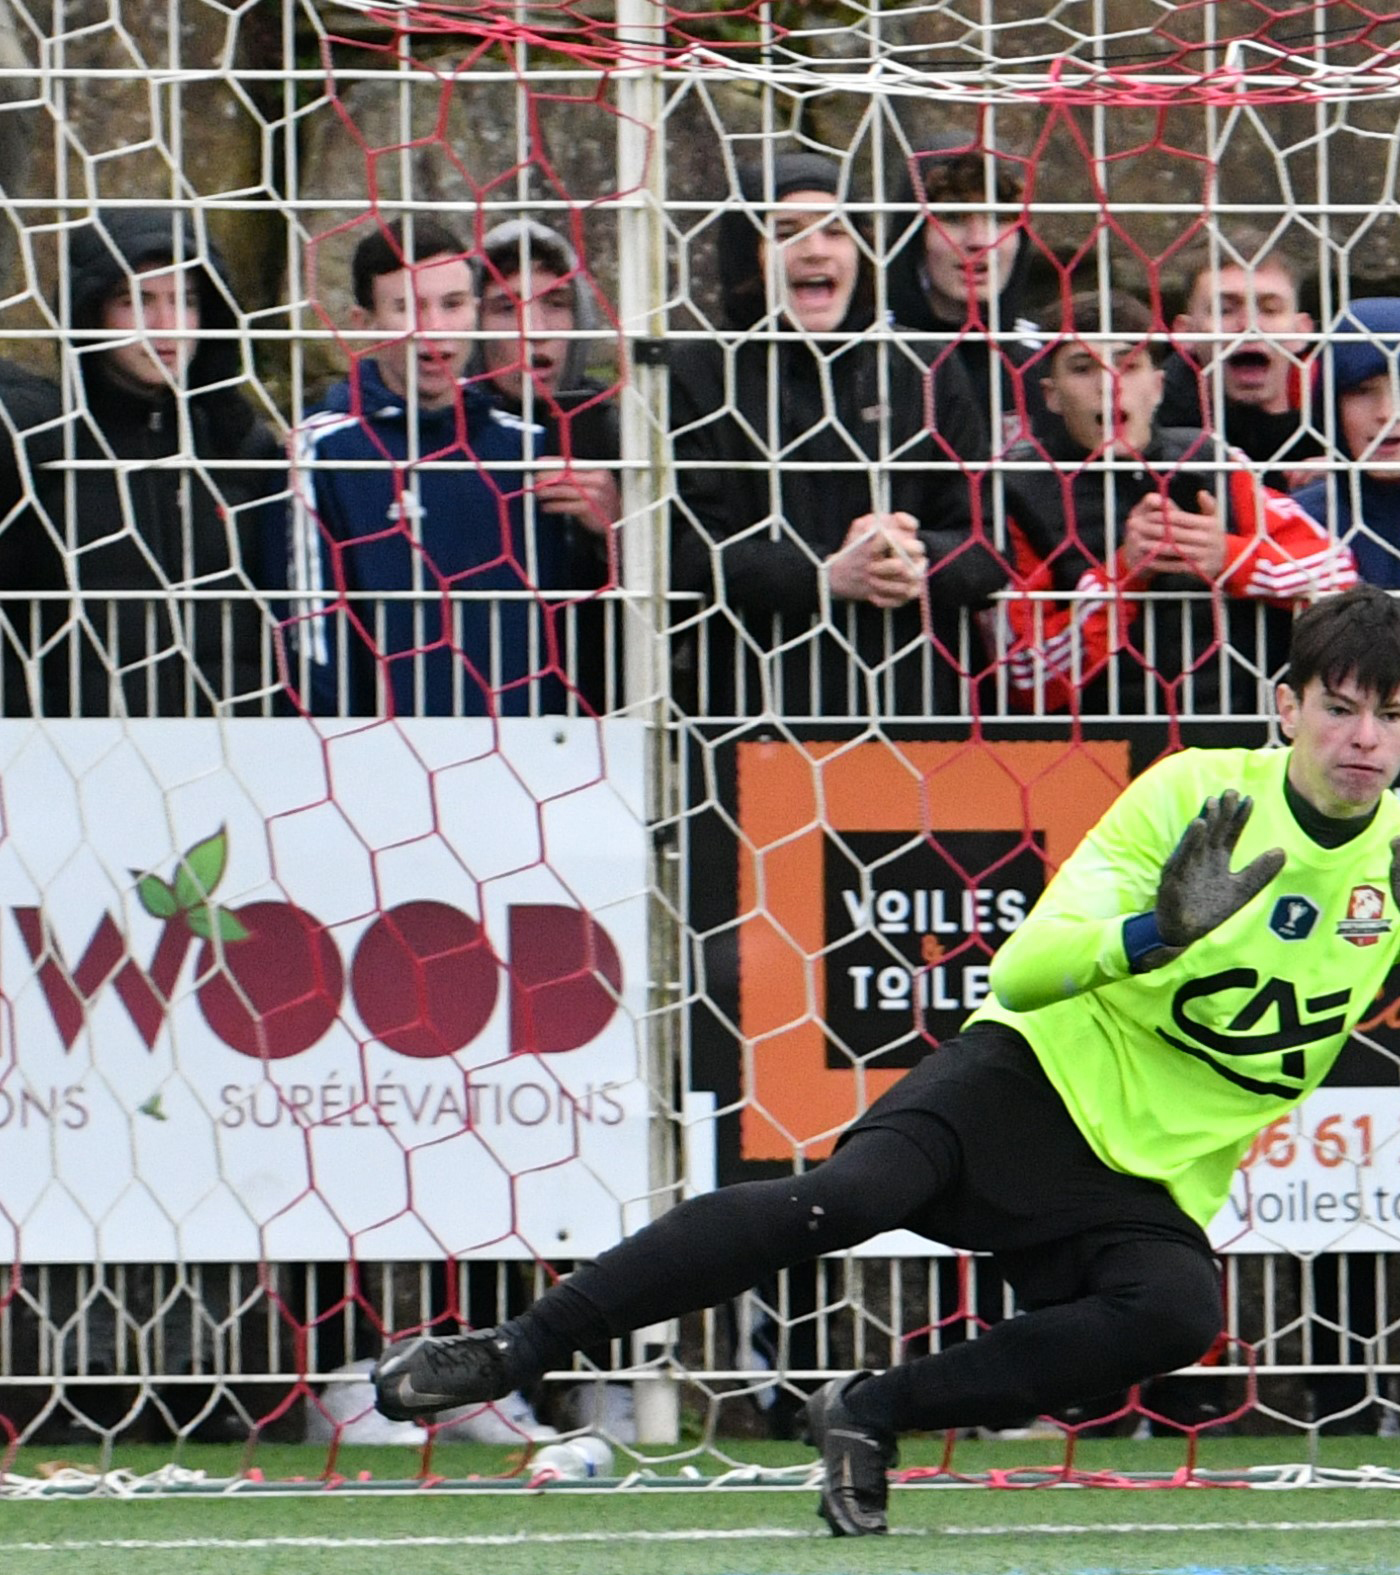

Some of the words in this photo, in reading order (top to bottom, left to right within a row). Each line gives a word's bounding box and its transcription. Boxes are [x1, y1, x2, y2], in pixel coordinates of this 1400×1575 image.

[842, 889, 1027, 933] VOILES
[12, 900, 623, 1059] WOOD
[848, 965, 990, 1010] TOILE
[220, 1071, 624, 1129] SURÉLÉVATIONS
[1313, 1114, 1374, 1167] 61
